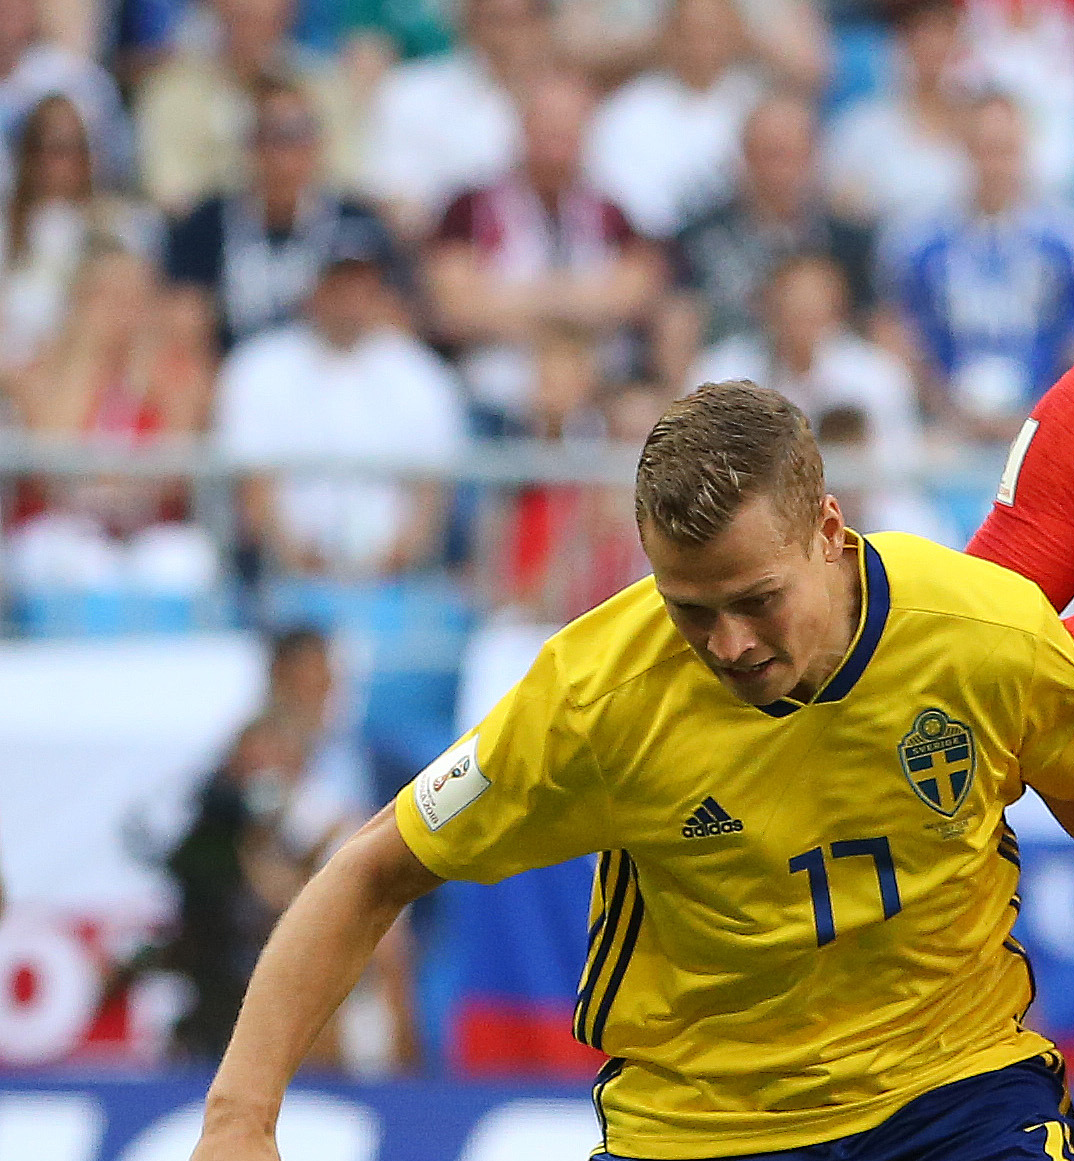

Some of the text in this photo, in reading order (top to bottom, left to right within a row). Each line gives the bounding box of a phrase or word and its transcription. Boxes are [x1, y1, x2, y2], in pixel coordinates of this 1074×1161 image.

[911, 736, 961, 755] SVERIGE
[681, 818, 744, 838] adidas
[788, 835, 903, 948] 17
